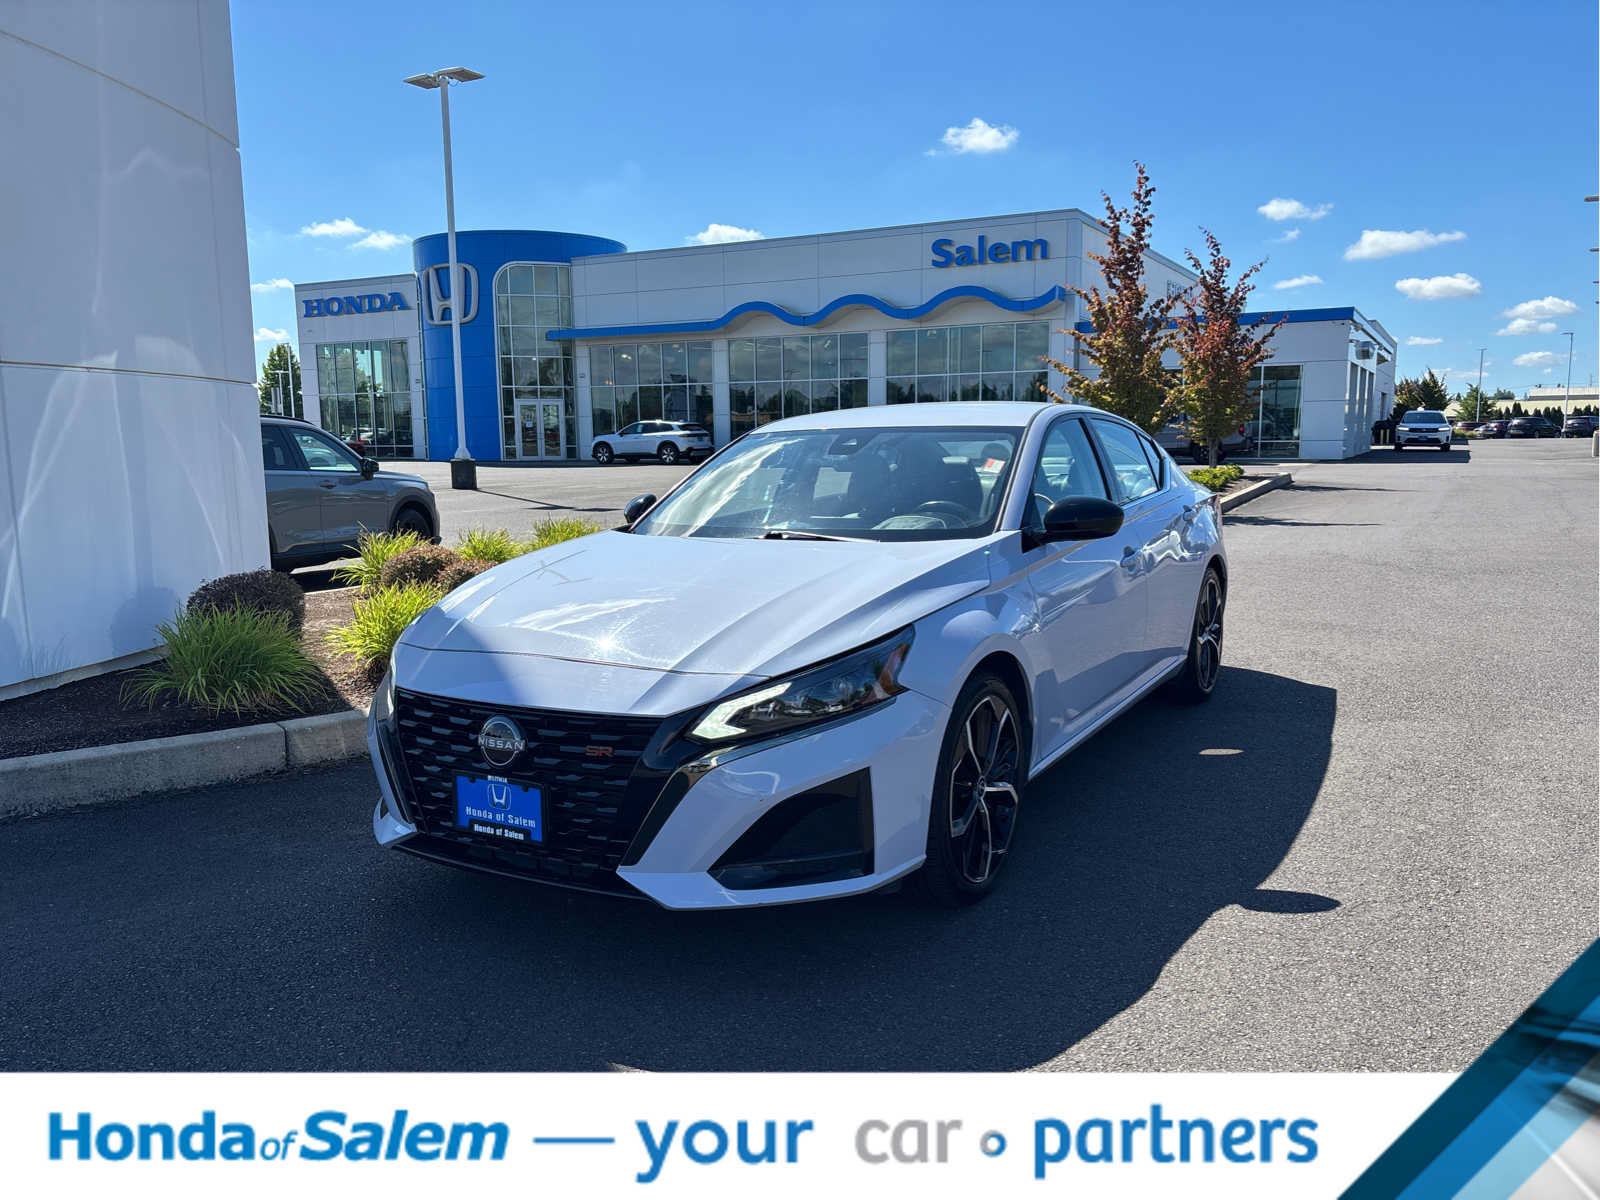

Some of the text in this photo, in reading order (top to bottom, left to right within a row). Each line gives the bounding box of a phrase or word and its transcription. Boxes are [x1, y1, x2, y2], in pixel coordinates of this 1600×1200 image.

[931, 235, 1049, 268] Salem
[303, 292, 409, 318] HONDA
[478, 735, 525, 751] NISSAN
[585, 745, 614, 757] SR
[465, 806, 536, 828] Honda of Salem
[474, 823, 495, 835] Honda
[504, 829, 525, 841] Salem
